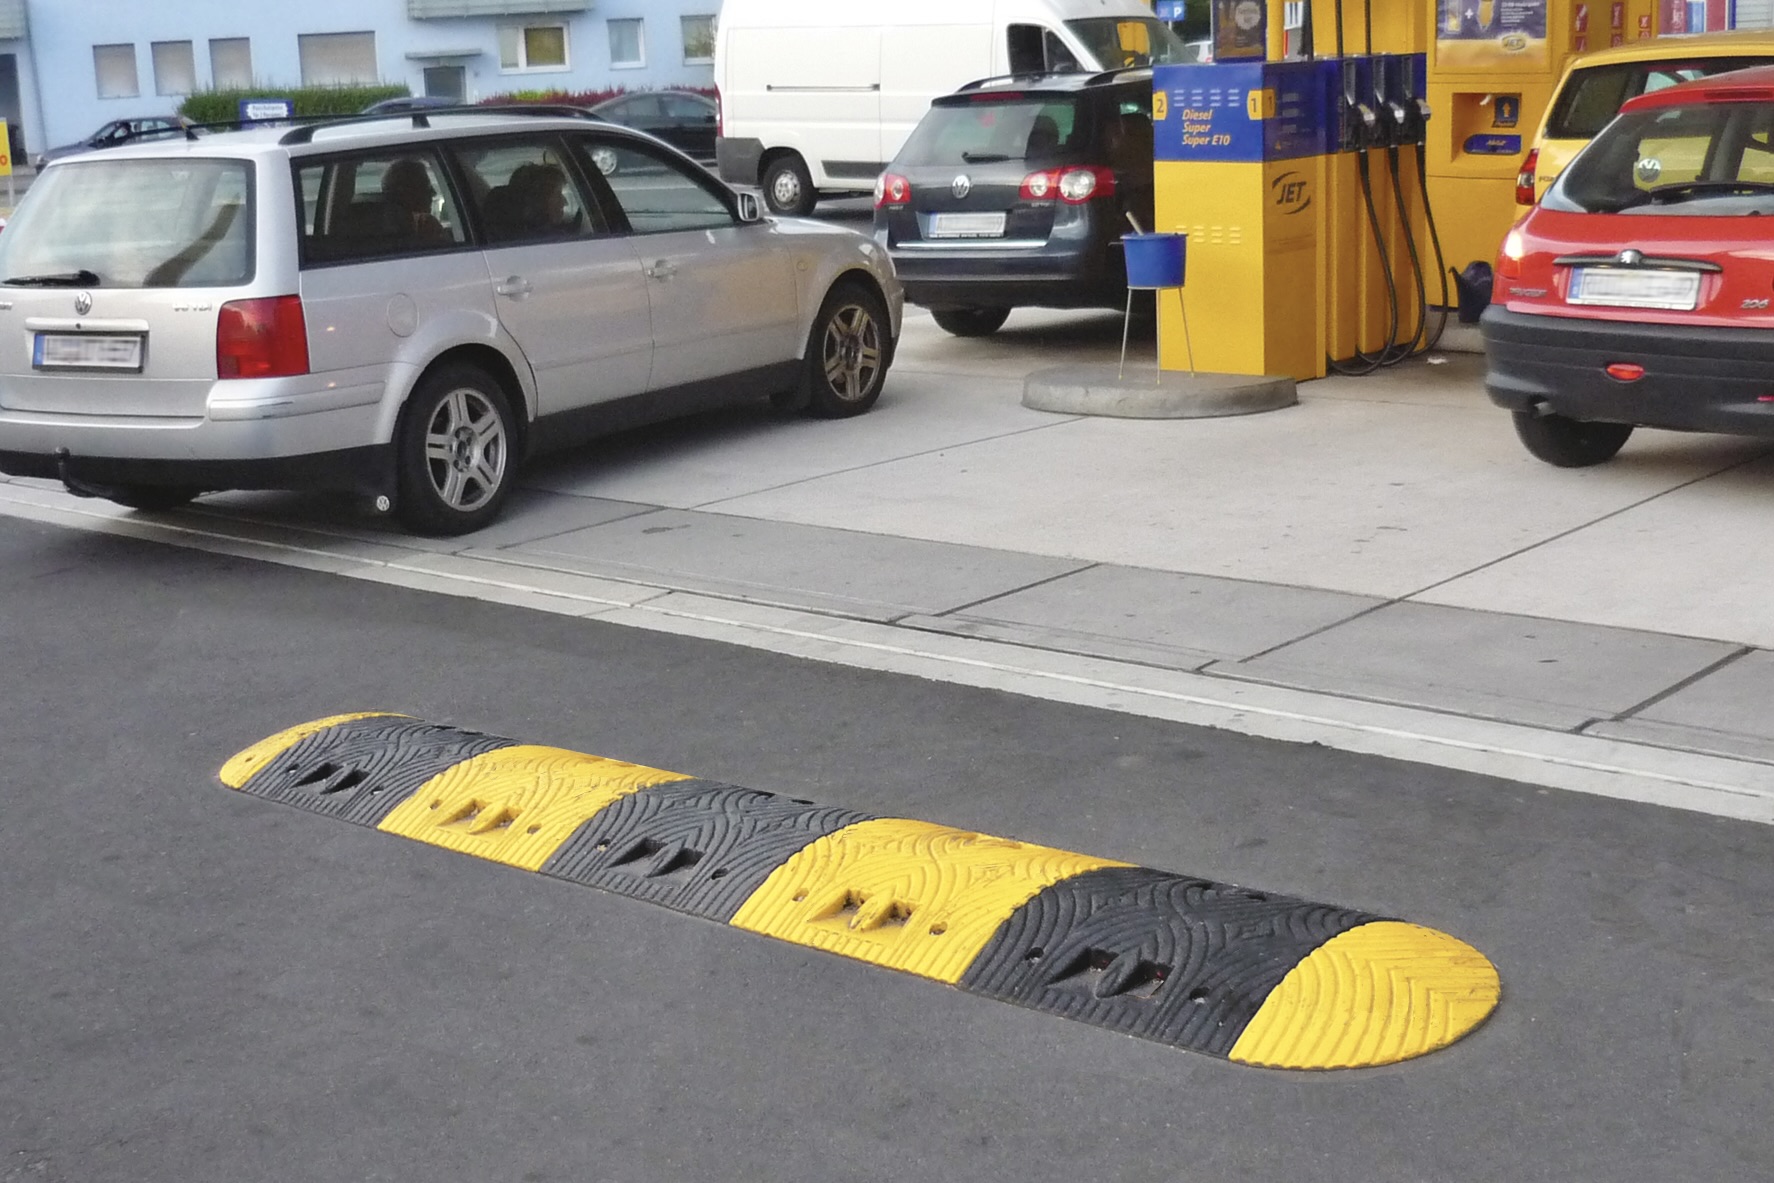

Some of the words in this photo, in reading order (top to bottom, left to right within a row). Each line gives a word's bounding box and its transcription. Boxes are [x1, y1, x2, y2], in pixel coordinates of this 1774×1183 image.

[1173, 6, 1182, 18] P
[1156, 98, 1164, 113] 2
[1250, 97, 1257, 113] 1
[1182, 109, 1213, 120] Diesel
[1182, 121, 1211, 135] Super
[1182, 134, 1209, 148] Super
[1211, 135, 1231, 146] E10
[1276, 181, 1307, 205] JET
